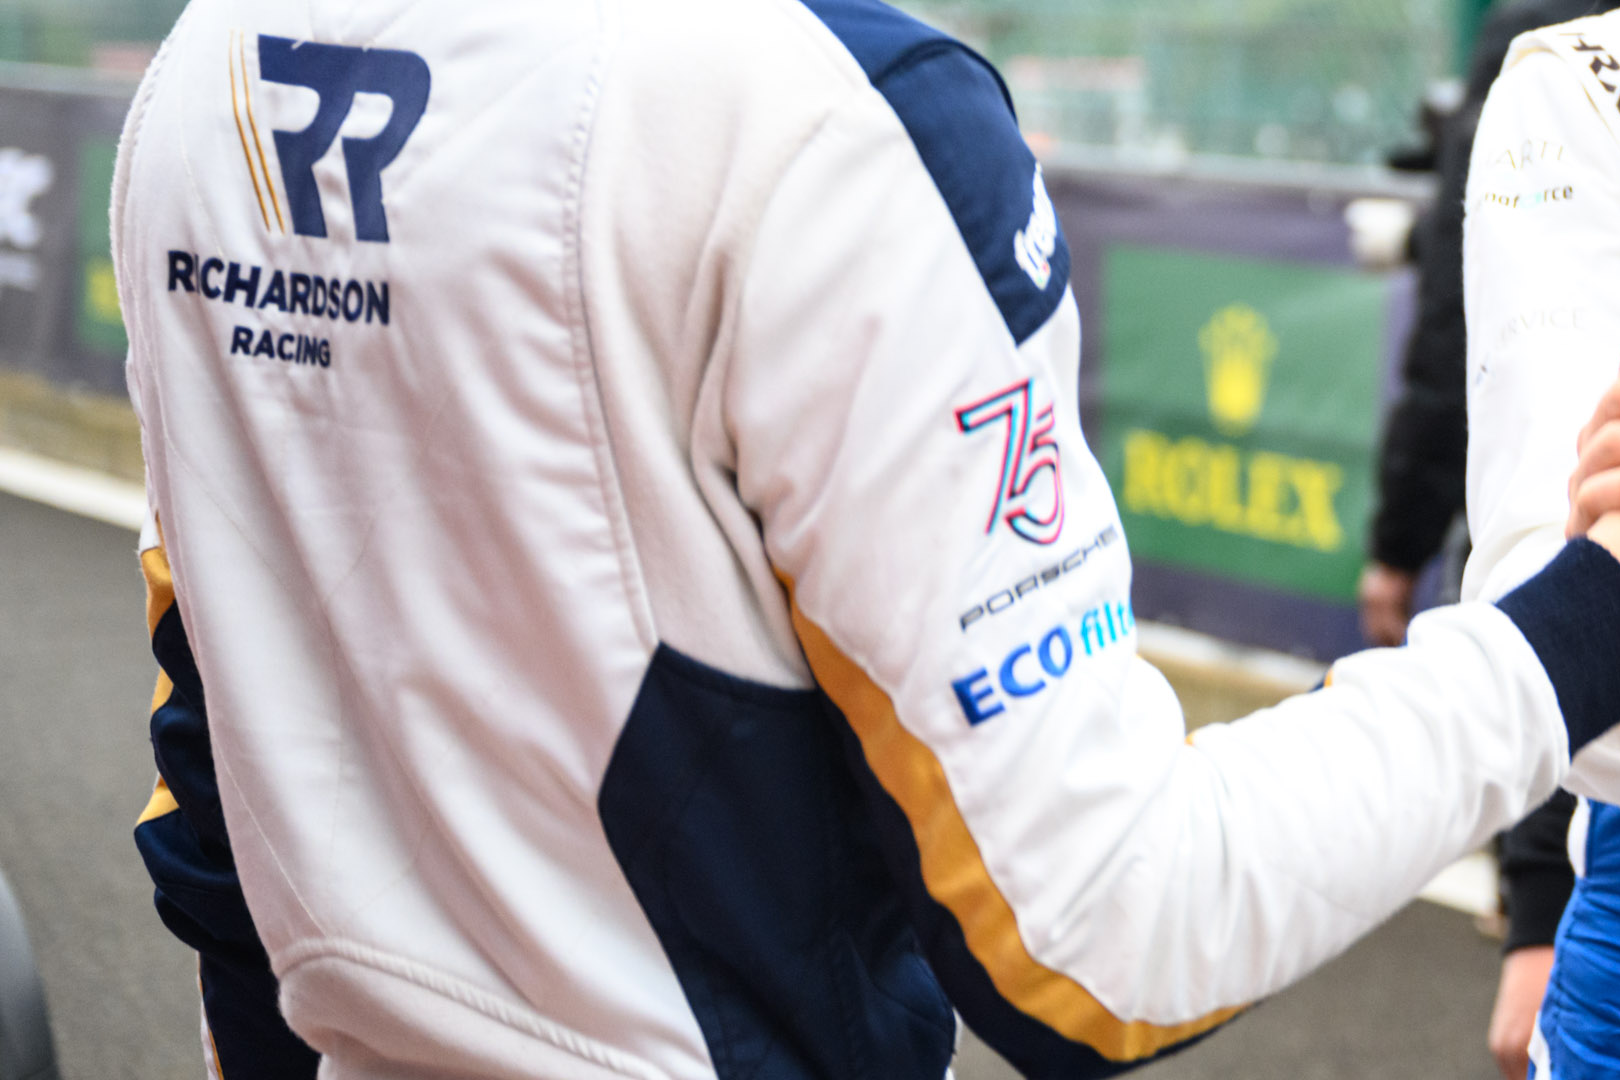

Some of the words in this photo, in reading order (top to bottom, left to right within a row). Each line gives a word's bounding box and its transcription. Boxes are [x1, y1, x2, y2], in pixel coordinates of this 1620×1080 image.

[167, 249, 391, 326] RICHARDSON
[230, 325, 332, 369] RACING
[954, 376, 1065, 546] 75
[1122, 427, 1346, 554] ROLEX
[958, 523, 1119, 633] PORSCHE
